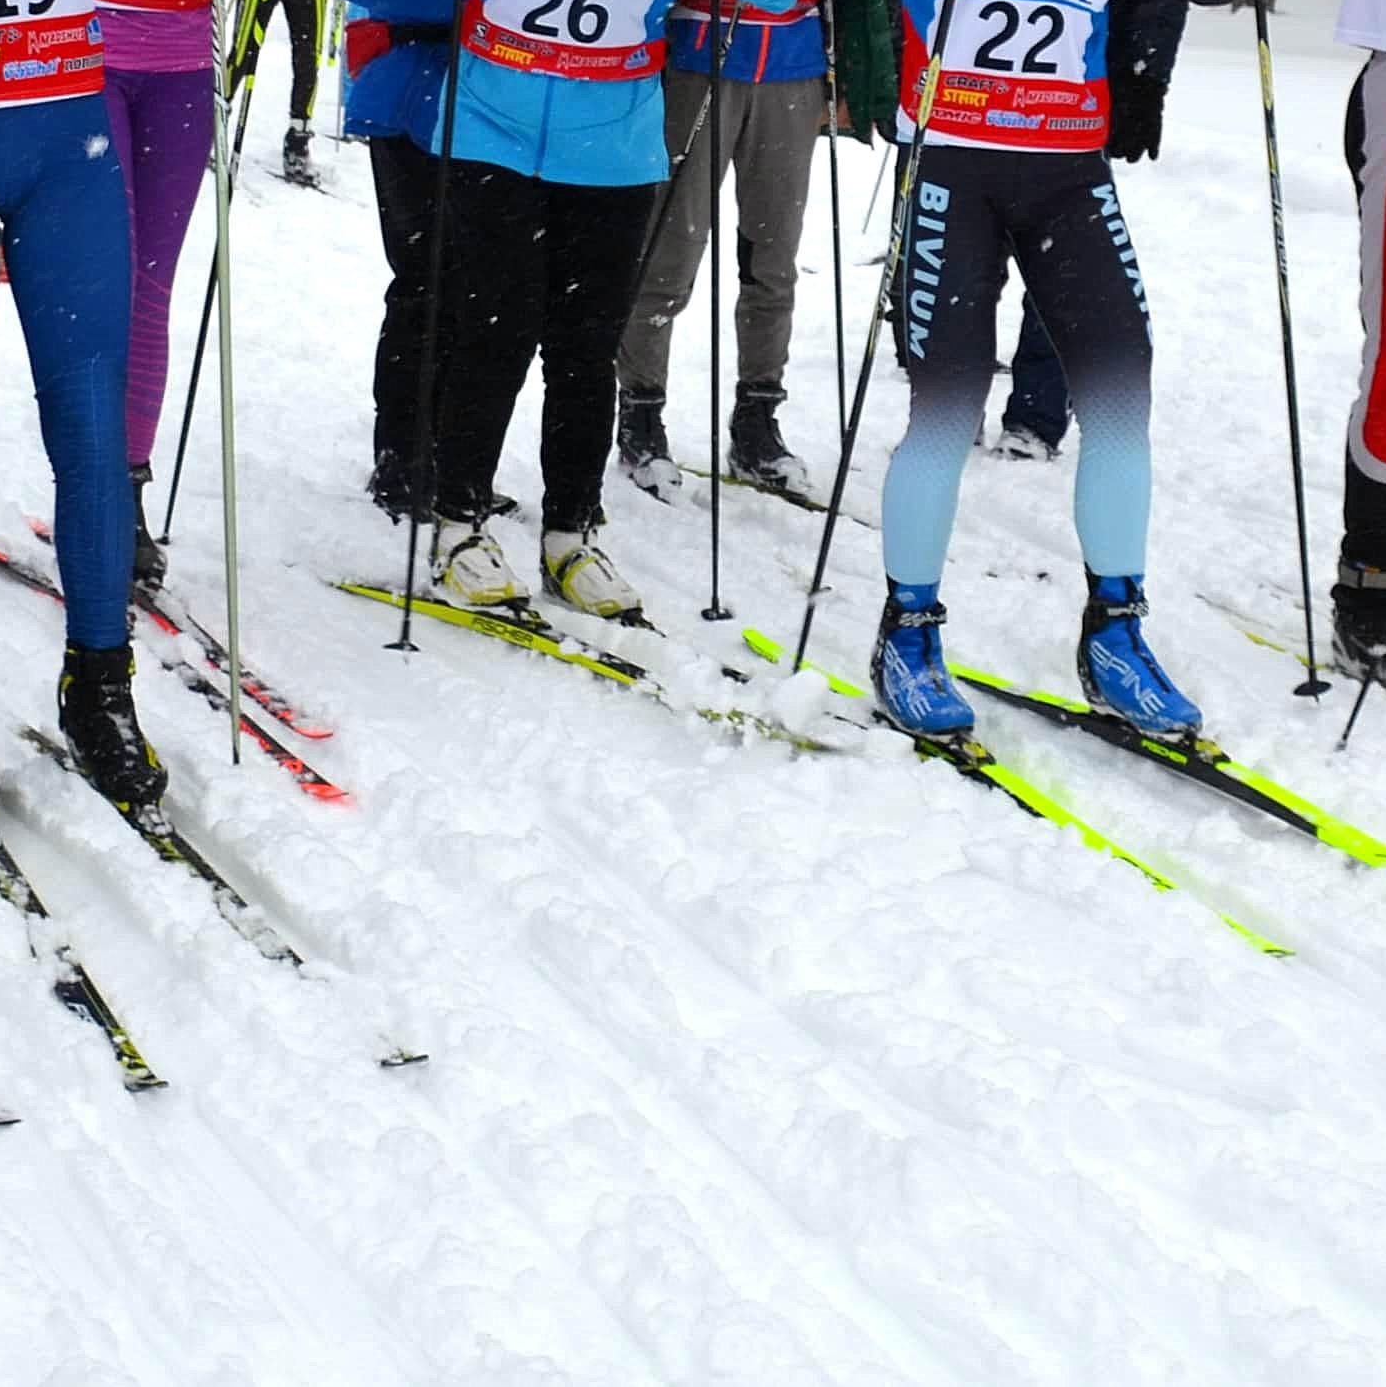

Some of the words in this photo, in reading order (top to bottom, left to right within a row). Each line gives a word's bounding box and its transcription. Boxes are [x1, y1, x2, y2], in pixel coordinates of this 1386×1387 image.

[492, 43, 537, 66] START
[974, 0, 1065, 74] 22
[941, 88, 990, 107] START
[946, 75, 995, 91] CRAFT
[909, 181, 950, 360] BIVIUM
[1089, 640, 1166, 715] SPINE
